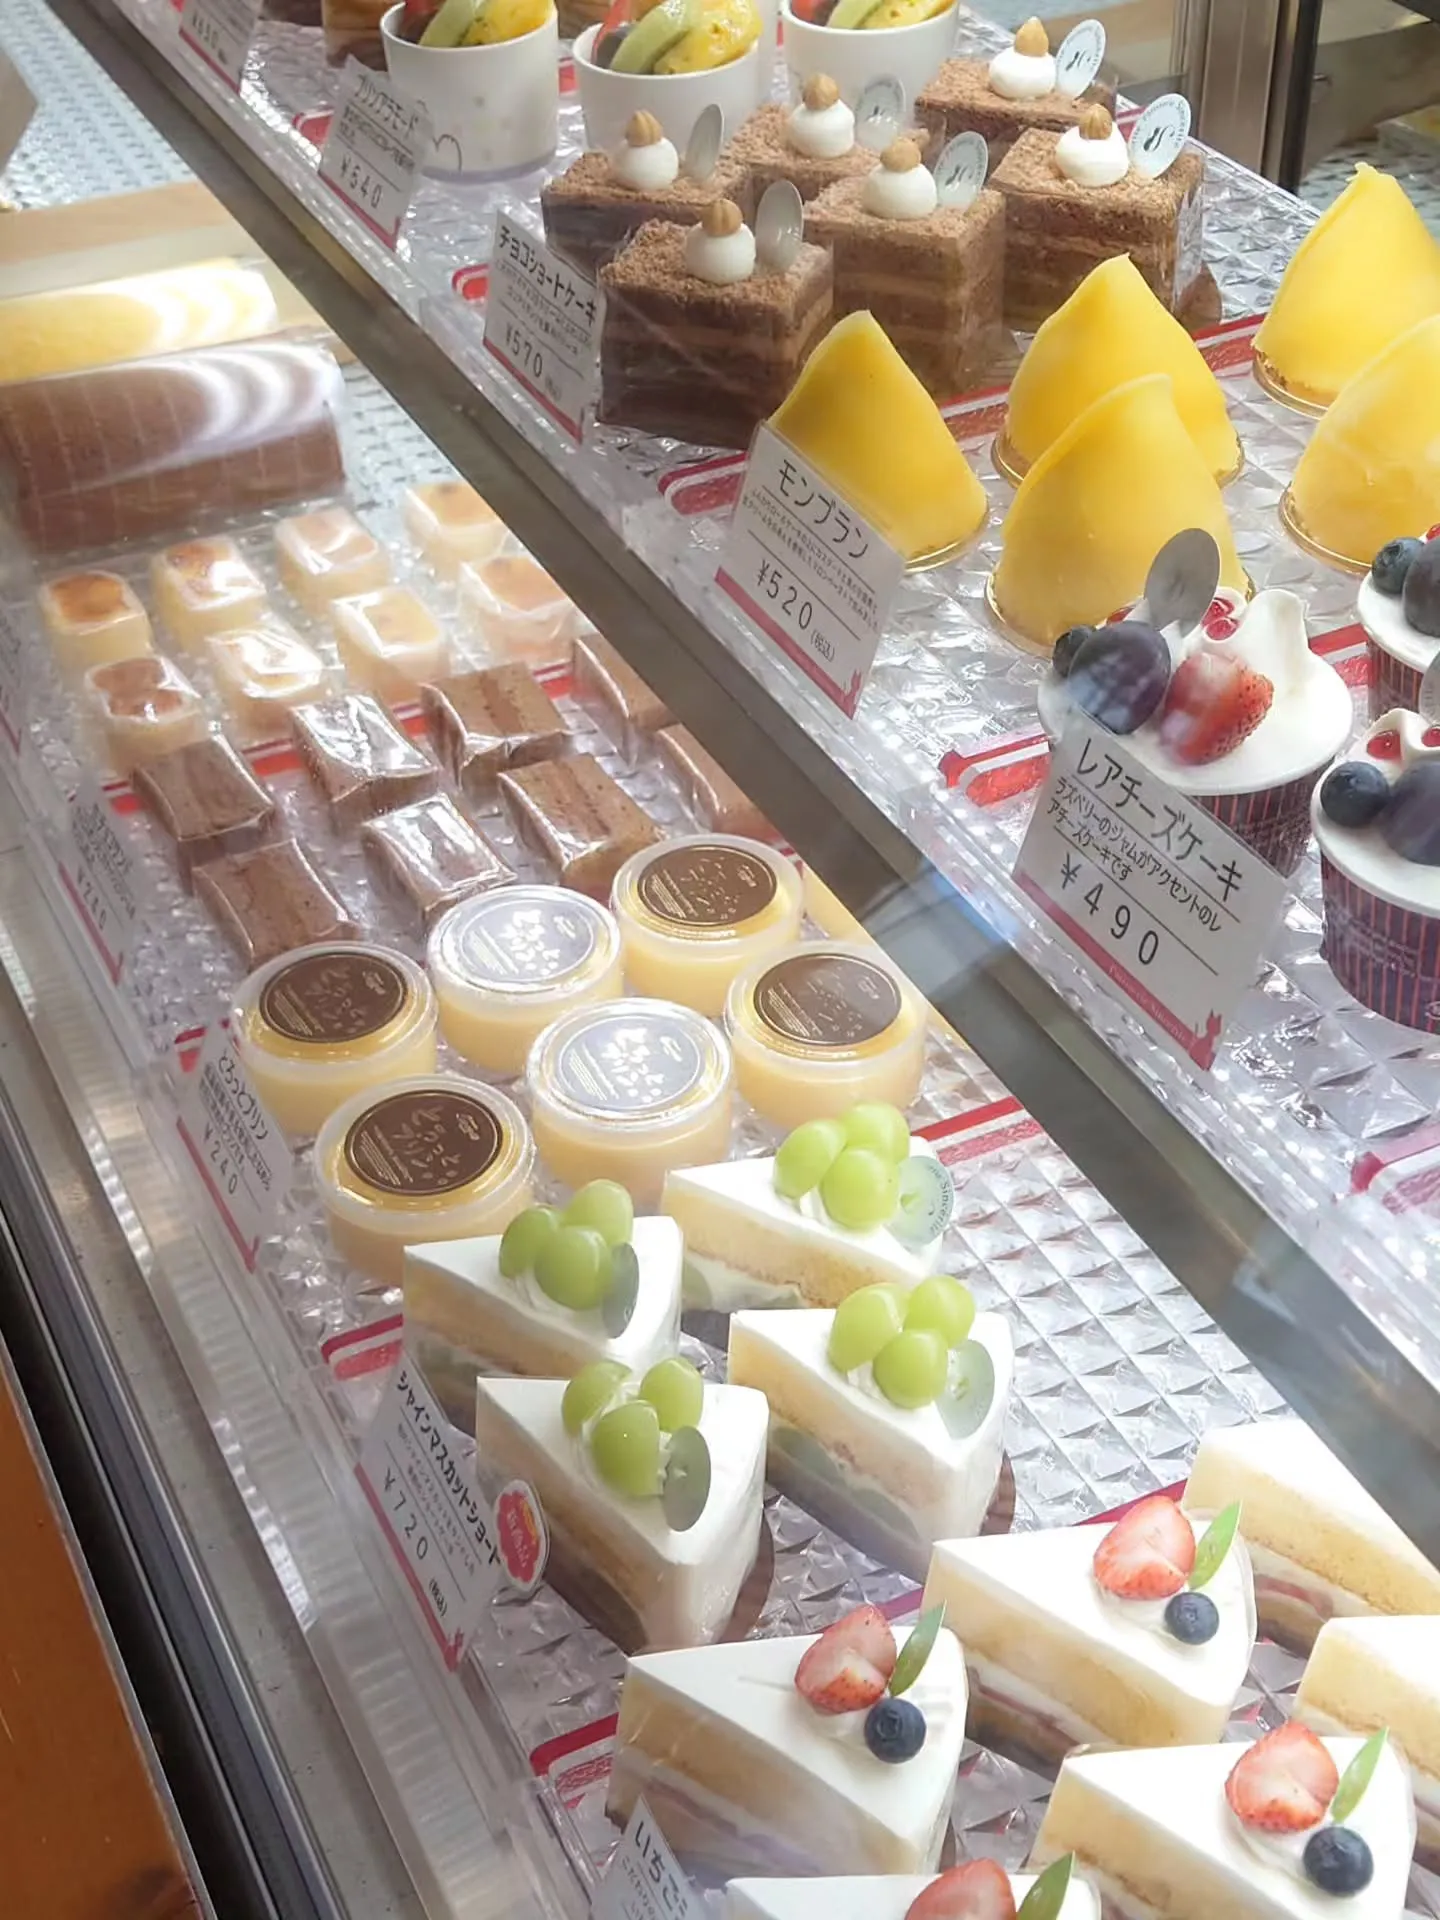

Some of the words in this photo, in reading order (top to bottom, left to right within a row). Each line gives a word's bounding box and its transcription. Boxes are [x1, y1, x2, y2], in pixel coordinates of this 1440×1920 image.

[340, 154, 384, 209] ¥540
[499, 225, 597, 327] チョコショートケーキ
[505, 323, 543, 378] ¥570
[778, 459, 868, 559] モンブラン
[756, 558, 813, 632] ¥520
[1047, 798, 1134, 882] アチーズケーキです
[1055, 776, 1222, 933] ラズベリーのジャムがアクセントのレ
[1075, 738, 1243, 902] レアチーズケーキ
[1060, 852, 1160, 966] ¥490
[384, 1467, 428, 1560] ¥720
[397, 1371, 501, 1566] シャインマスカットショート
